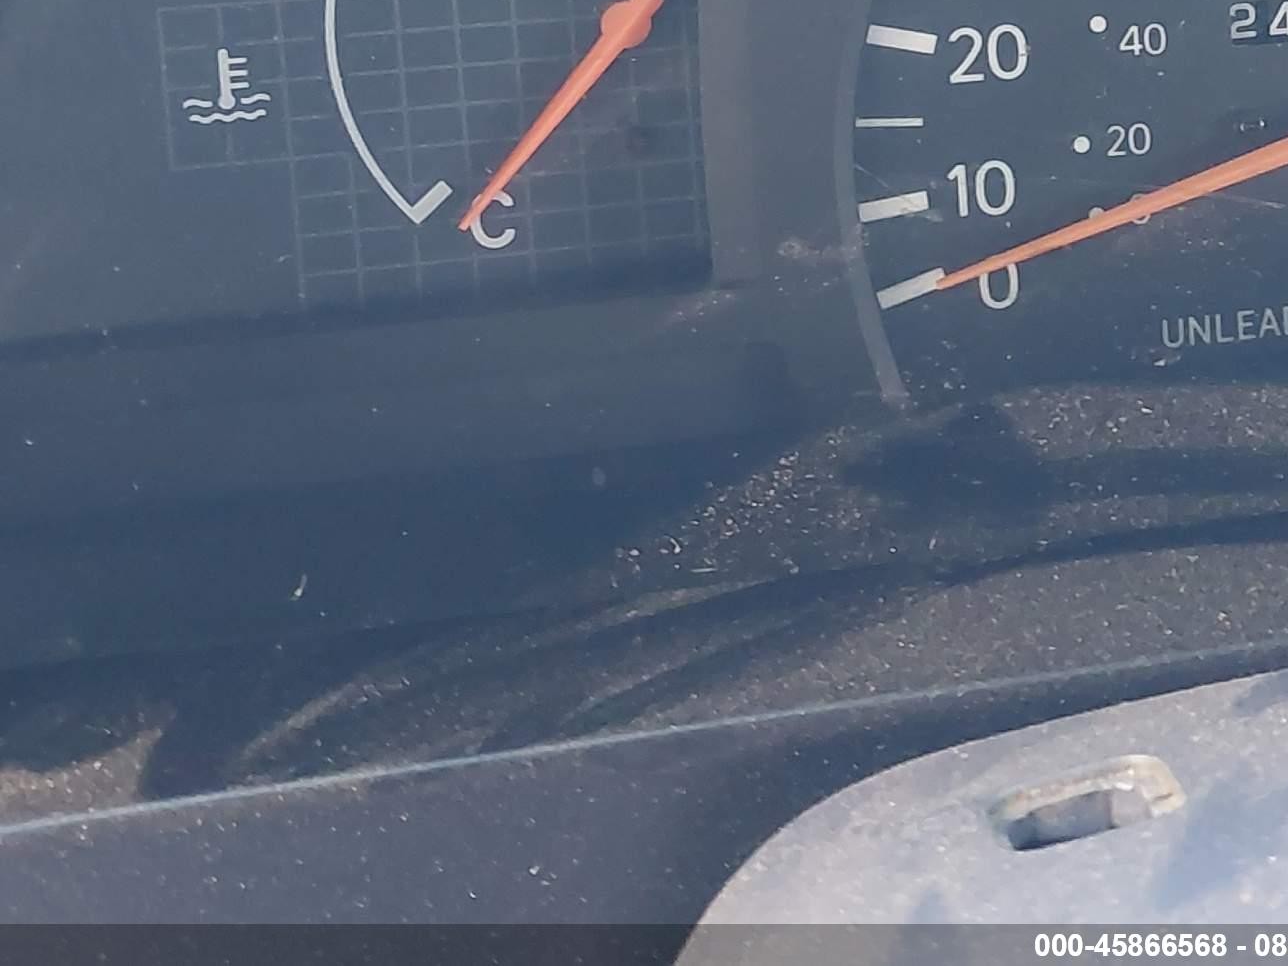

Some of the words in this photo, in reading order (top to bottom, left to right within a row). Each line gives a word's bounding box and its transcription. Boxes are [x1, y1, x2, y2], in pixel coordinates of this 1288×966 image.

[948, 24, 1029, 84] 20
[1119, 23, 1167, 57] 40
[1106, 123, 1152, 157] 20
[946, 159, 1016, 218] 10
[470, 189, 516, 249] C
[979, 261, 1019, 309] 0
